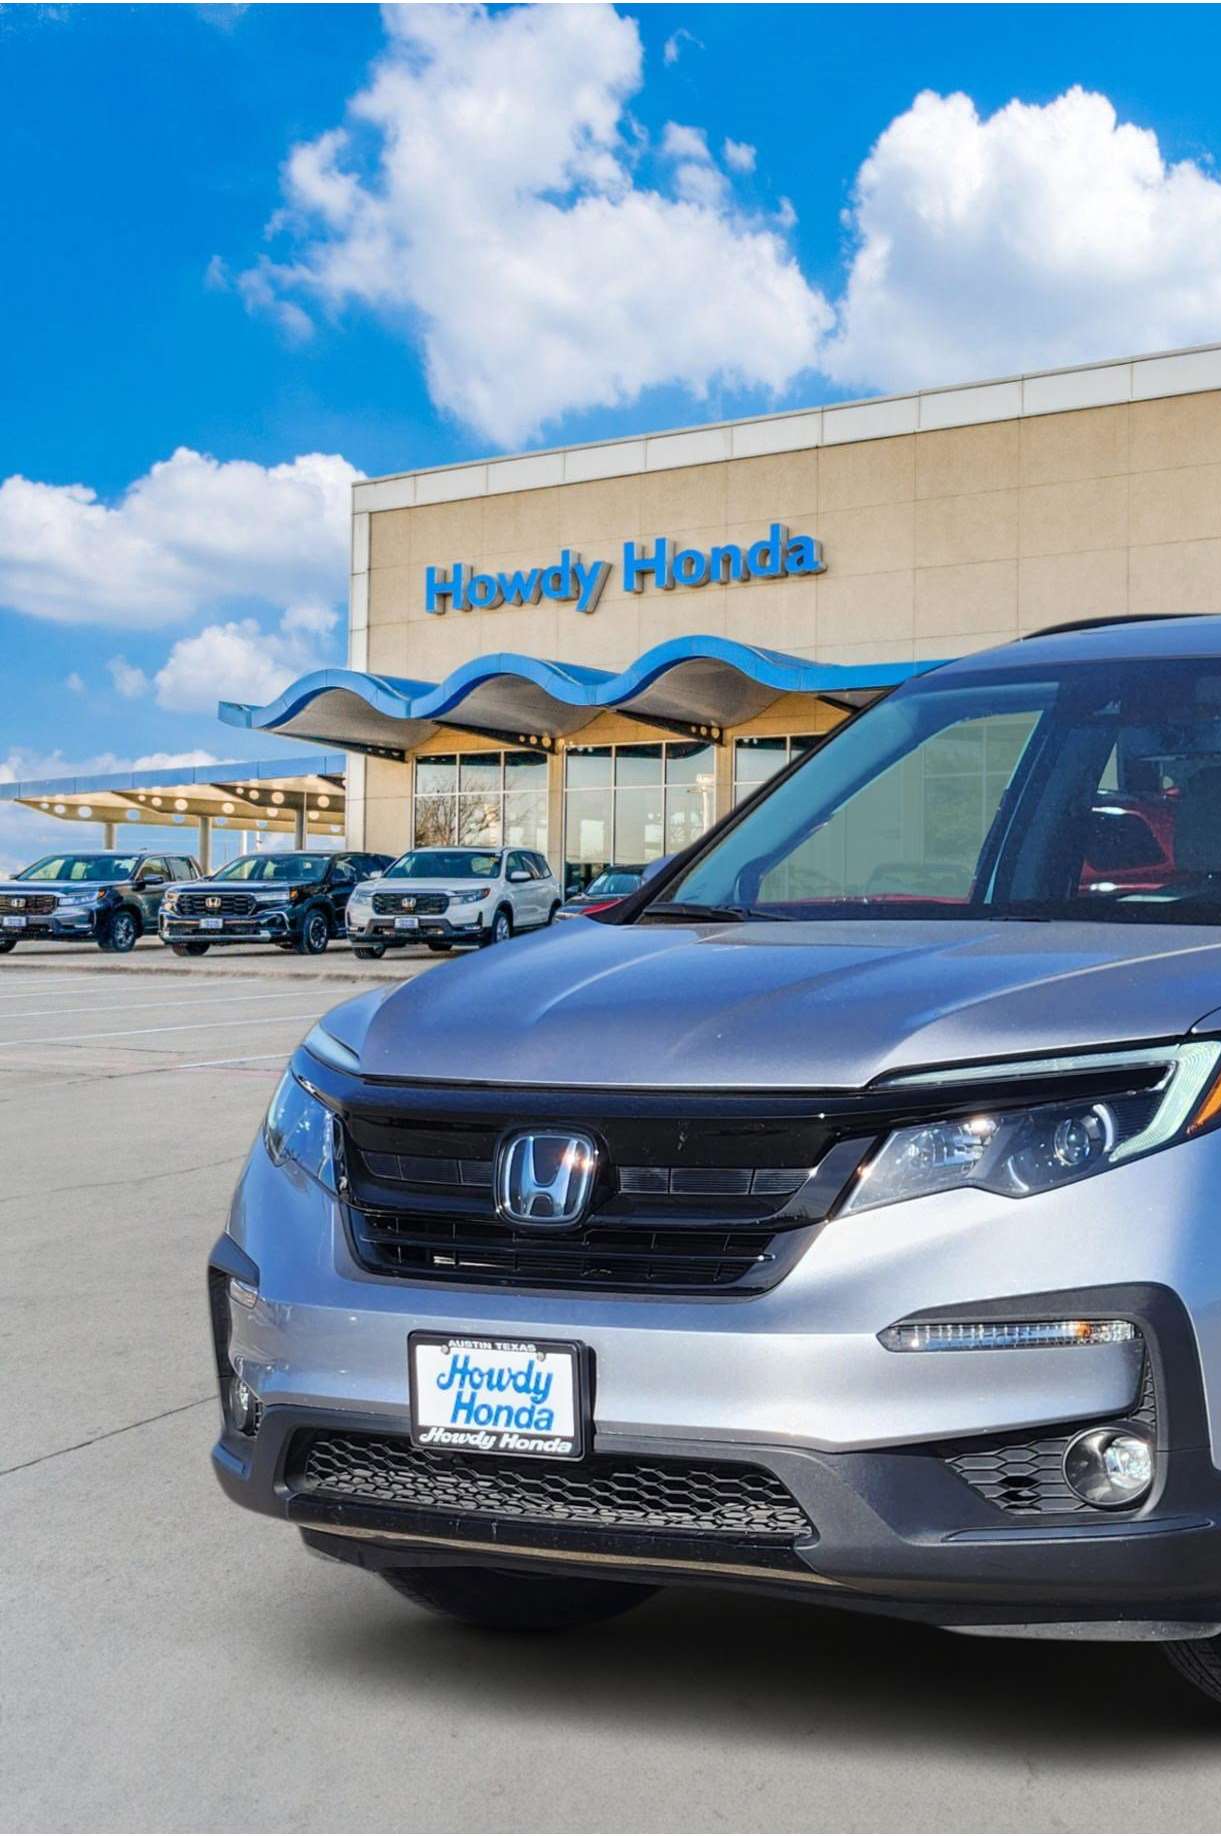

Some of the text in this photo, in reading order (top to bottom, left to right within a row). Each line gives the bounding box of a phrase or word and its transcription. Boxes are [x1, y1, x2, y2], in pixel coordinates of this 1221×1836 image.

[425, 522, 827, 615] Howdy Honda
[448, 1339, 537, 1353] AUSTIN TEXAS
[436, 1354, 554, 1405] Howdy
[450, 1390, 555, 1432] Honda
[419, 1427, 573, 1454] Howdy Honda
